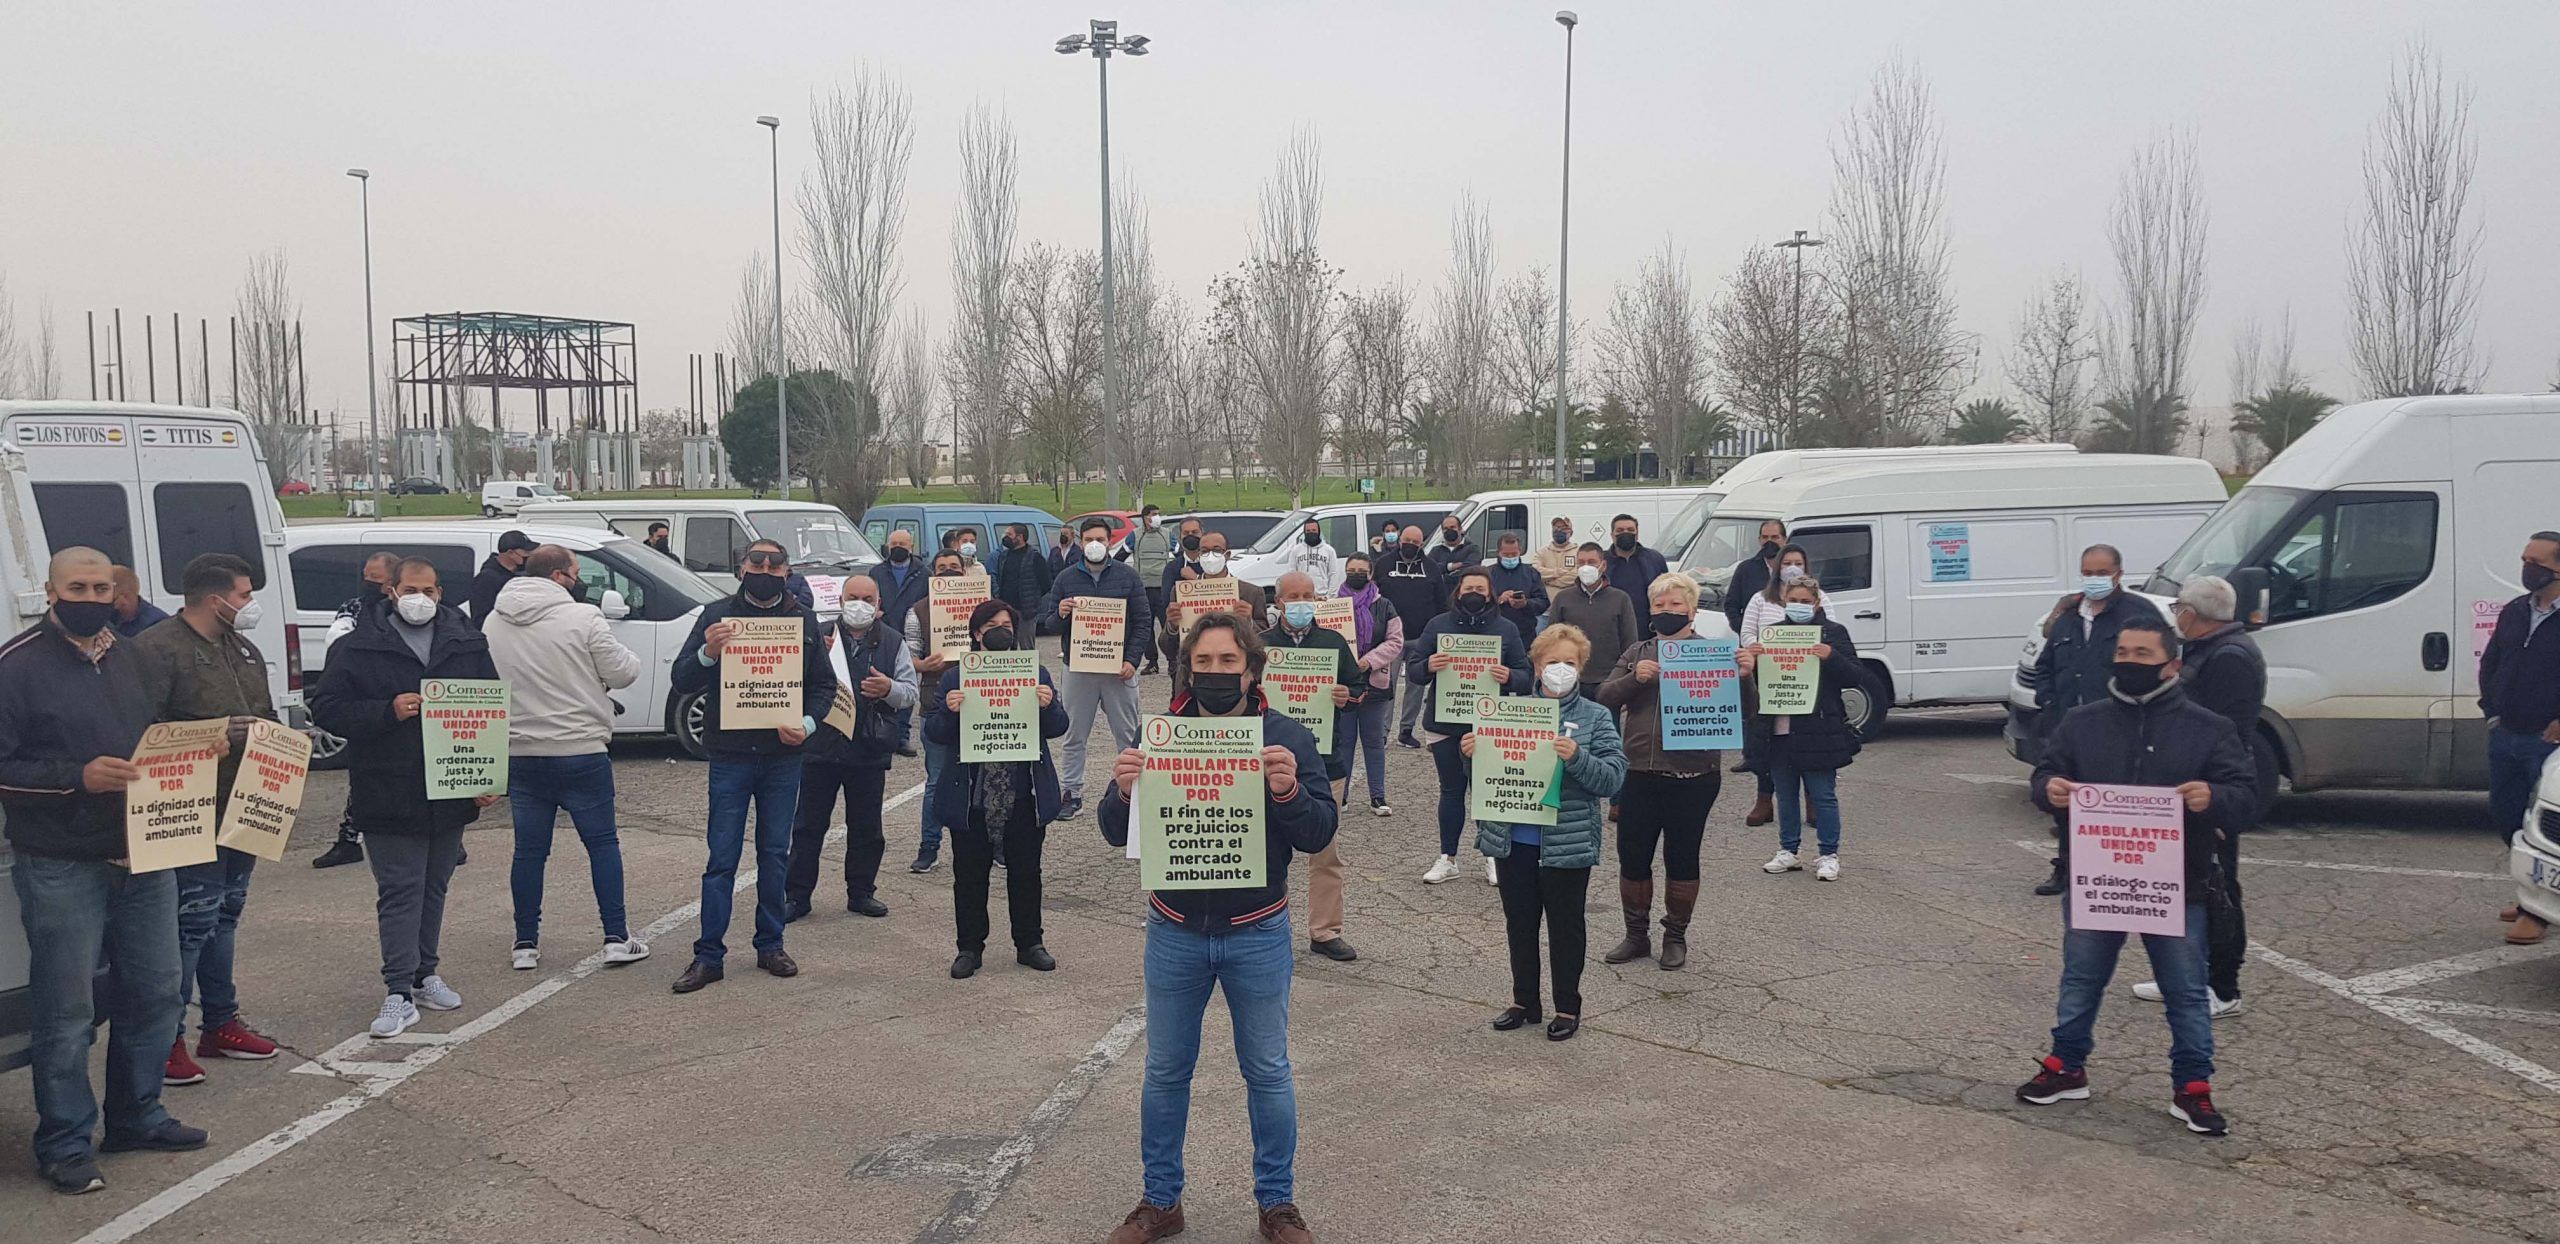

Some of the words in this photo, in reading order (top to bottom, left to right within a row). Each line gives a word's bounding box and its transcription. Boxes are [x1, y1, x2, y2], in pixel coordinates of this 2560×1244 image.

[36, 426, 61, 443] LOS
[65, 427, 106, 443] FOFOS
[167, 428, 212, 444] TITIS
[746, 622, 796, 631] Comacor
[944, 624, 967, 634] dignid
[1456, 638, 1496, 646] Comacor
[725, 646, 800, 654] AMBULANTES
[1681, 644, 1731, 654] Comacor
[742, 656, 782, 664] UNIDOS
[983, 655, 1032, 665] Comacor
[1286, 652, 1332, 662] Comacor
[752, 666, 773, 674] POR
[1453, 664, 1485, 672] UNIDOS
[1266, 673, 1334, 684] AMBULANTES
[1663, 669, 1735, 679] AMBULANTES
[739, 680, 783, 692] dignidad
[964, 678, 1036, 688] AMBULANTES
[1281, 684, 1318, 693] UNIDOS
[1680, 680, 1720, 689] UNIDOS
[447, 684, 504, 695] Comacor
[739, 690, 787, 698] comercio
[980, 688, 1020, 697] UNIDOS
[1690, 690, 1711, 698] POR
[989, 699, 1010, 707] POR
[1288, 694, 1308, 702] POR
[1768, 698, 1806, 708] negociada
[1289, 706, 1306, 714] Una
[1446, 707, 1473, 716] negoci
[1498, 701, 1552, 714] Comacor
[1664, 706, 1673, 714] El
[1677, 705, 1715, 713] futuro
[1719, 704, 1737, 713] del
[426, 710, 506, 719] AMBULANTES
[991, 712, 1009, 720] Una
[1674, 715, 1728, 725] comercio
[443, 721, 487, 729] UNIDOS
[972, 722, 1027, 730] ordenanza
[171, 725, 222, 738] Comacor
[452, 731, 476, 739] POR
[982, 731, 1009, 741] justa
[1012, 732, 1018, 741] y
[1174, 724, 1253, 739] Comacor
[1477, 727, 1555, 740] AMBULANTES
[1671, 728, 1732, 736] ambulante
[271, 728, 307, 750] Comacor
[454, 745, 474, 753] Una
[974, 740, 1027, 754] negociada
[1494, 739, 1536, 751] UNIDOS
[135, 748, 213, 766] AMBULANTES
[436, 757, 494, 765] ordenanza
[1504, 751, 1526, 761] POR
[247, 750, 305, 778] AMBULANTES
[1146, 757, 1260, 771] AMBULANTES
[150, 764, 193, 778] UNIDOS
[259, 766, 290, 784] UNIDOS
[445, 766, 473, 776] justa
[1505, 766, 1525, 776] Una
[160, 779, 184, 792] POR
[438, 776, 493, 790] negociada
[1172, 774, 1234, 786] UNIDOS
[1486, 777, 1544, 788] ordenanza
[262, 781, 280, 793] POR
[1186, 789, 1220, 801] POR
[1495, 787, 1524, 798] justa
[1527, 792, 1534, 800] y
[2103, 791, 2174, 805] Comacor
[132, 805, 143, 815] La
[147, 798, 195, 817] dignidad
[198, 796, 215, 806] del
[234, 790, 244, 799] La
[247, 794, 283, 812] dignidad
[285, 806, 298, 816] del
[1486, 800, 1543, 812] negociada
[244, 805, 282, 823] comercio
[1160, 807, 1172, 818] El
[1178, 804, 1199, 818] fin
[1205, 807, 1225, 818] de
[1230, 807, 1253, 818] los
[148, 811, 199, 826] comercio
[238, 815, 281, 835] ambulante
[1166, 820, 1249, 836] prejuicios
[145, 825, 202, 841] ambulante
[2078, 824, 2180, 841] AMBULANTES
[1169, 838, 1223, 849] contra
[1229, 838, 1242, 848] el
[2101, 838, 2156, 852] UNIDOS
[1170, 853, 1241, 864] mercado
[2114, 852, 2143, 864] POR
[1166, 868, 1251, 880] ambulante
[2077, 876, 2088, 885] El
[2093, 875, 2147, 893] diálogo
[2152, 881, 2179, 891] con
[2085, 890, 2097, 899] el
[2102, 891, 2171, 904] comercio
[2089, 904, 2168, 918] ambulante
